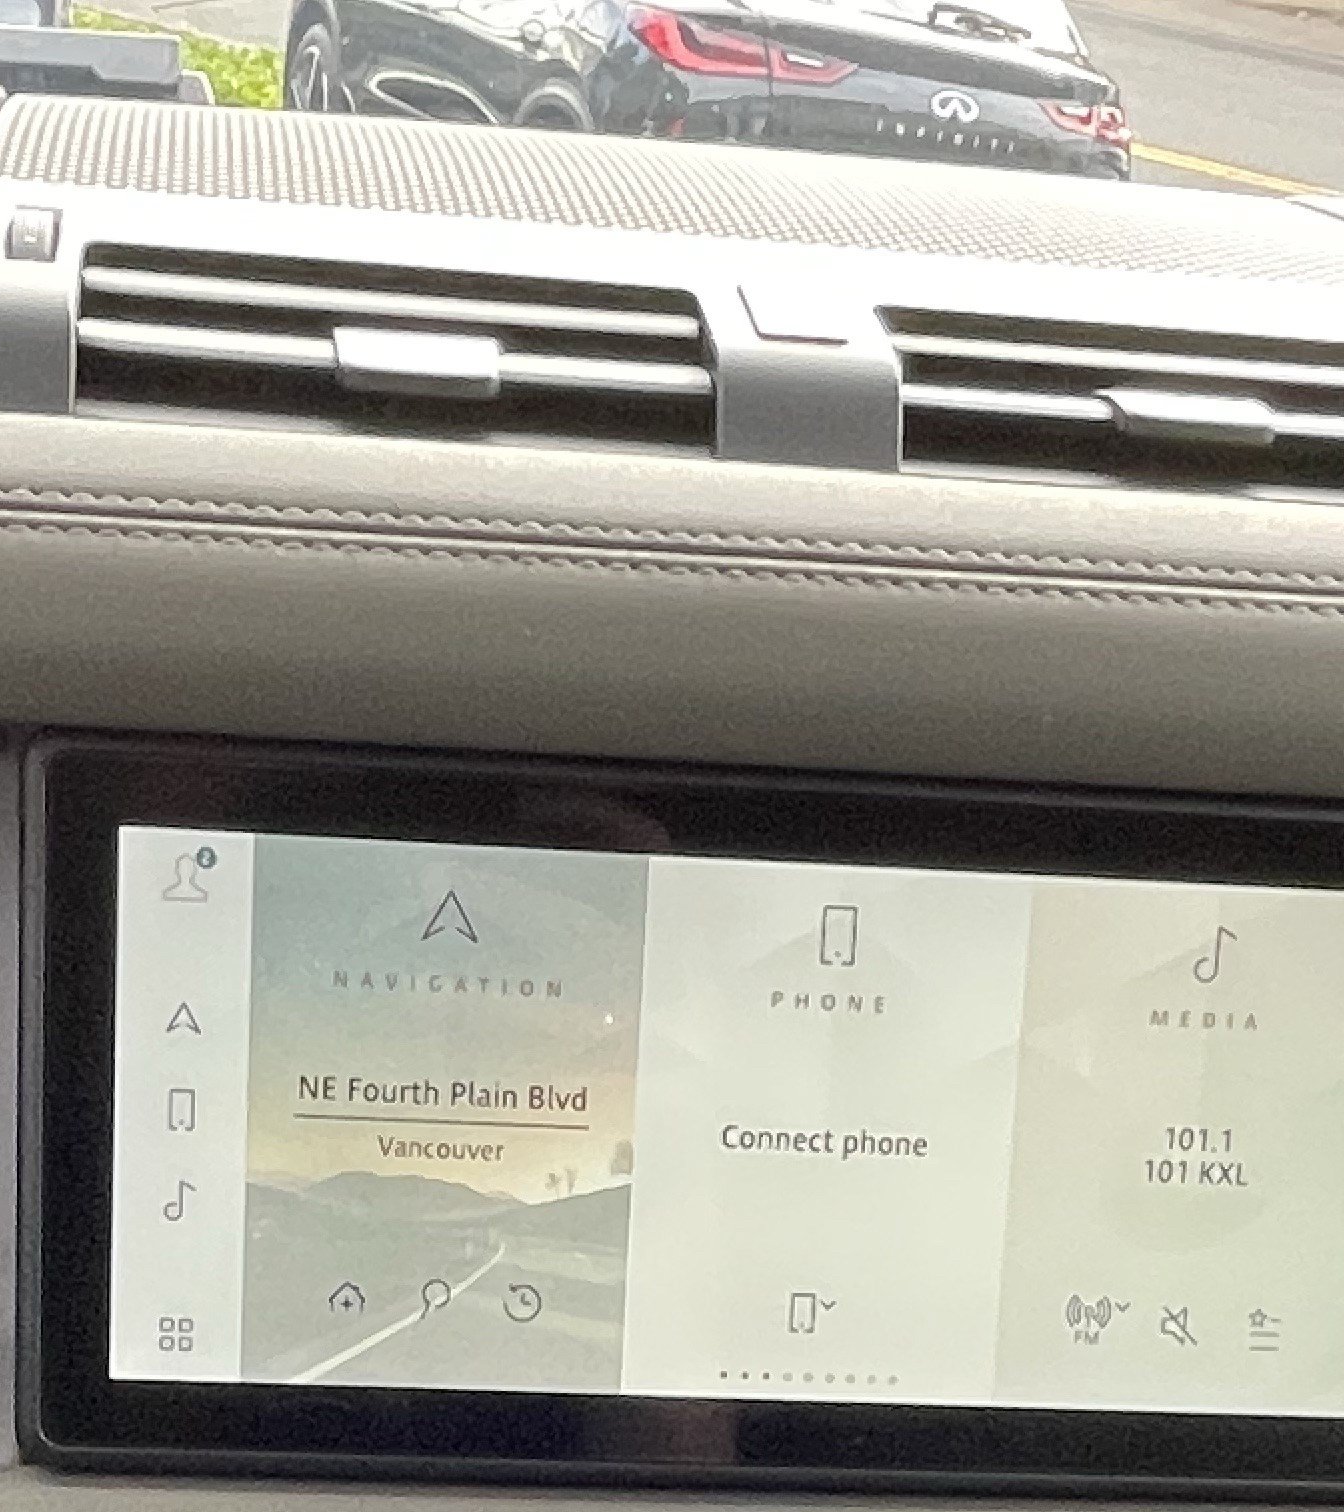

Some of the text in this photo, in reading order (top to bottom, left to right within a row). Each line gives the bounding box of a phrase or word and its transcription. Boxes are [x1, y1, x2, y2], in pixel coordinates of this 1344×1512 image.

[332, 970, 563, 998] NAVIGATION
[770, 991, 888, 1015] PHONE
[1149, 1008, 1260, 1031] MEDIA
[297, 1074, 589, 1113] NE Fourth Plain Blvd
[376, 1135, 506, 1163] Vancouver
[720, 1124, 929, 1163] Connect phone
[1164, 1126, 1234, 1153] 101.1
[1142, 1158, 1249, 1187] 101 KXL
